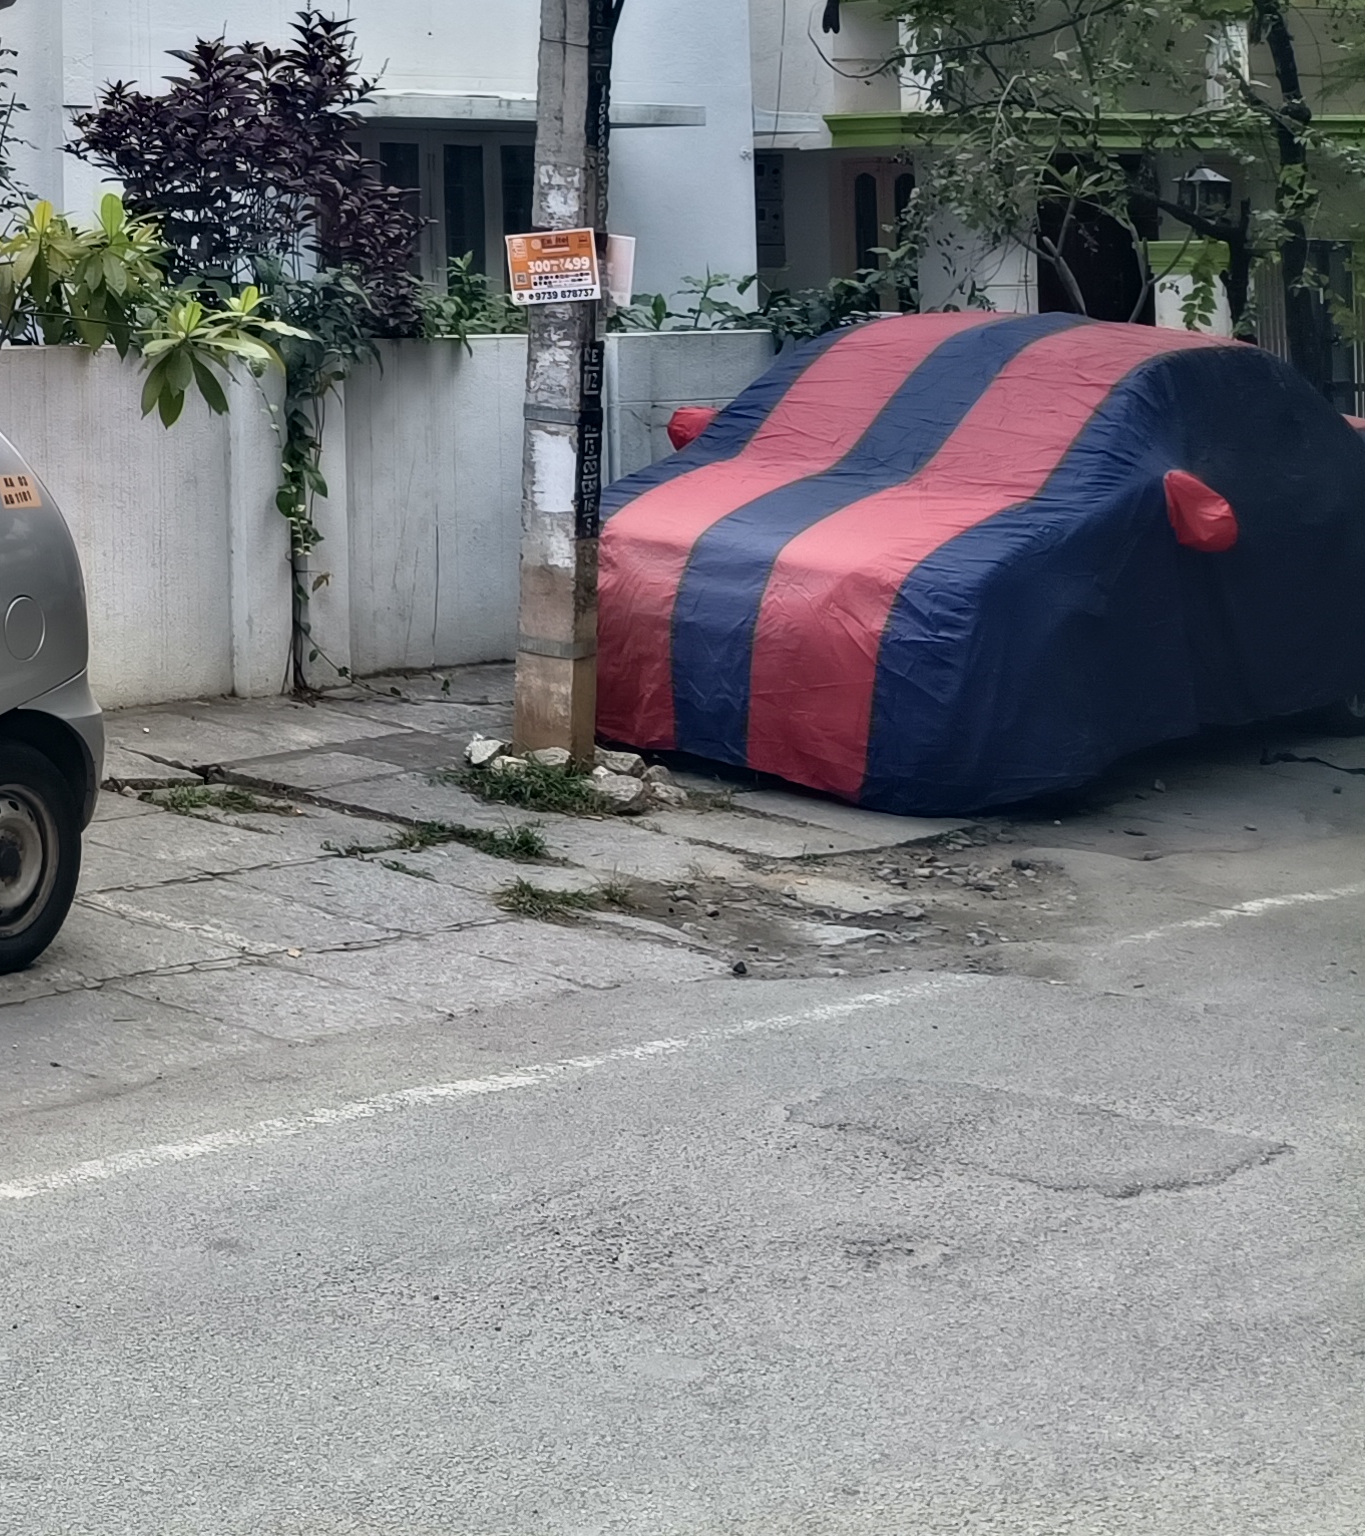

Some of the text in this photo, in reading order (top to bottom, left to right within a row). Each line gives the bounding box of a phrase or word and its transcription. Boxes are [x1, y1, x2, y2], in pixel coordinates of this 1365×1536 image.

[528, 261, 550, 273] 300
[535, 288, 594, 300] 9739 878737
